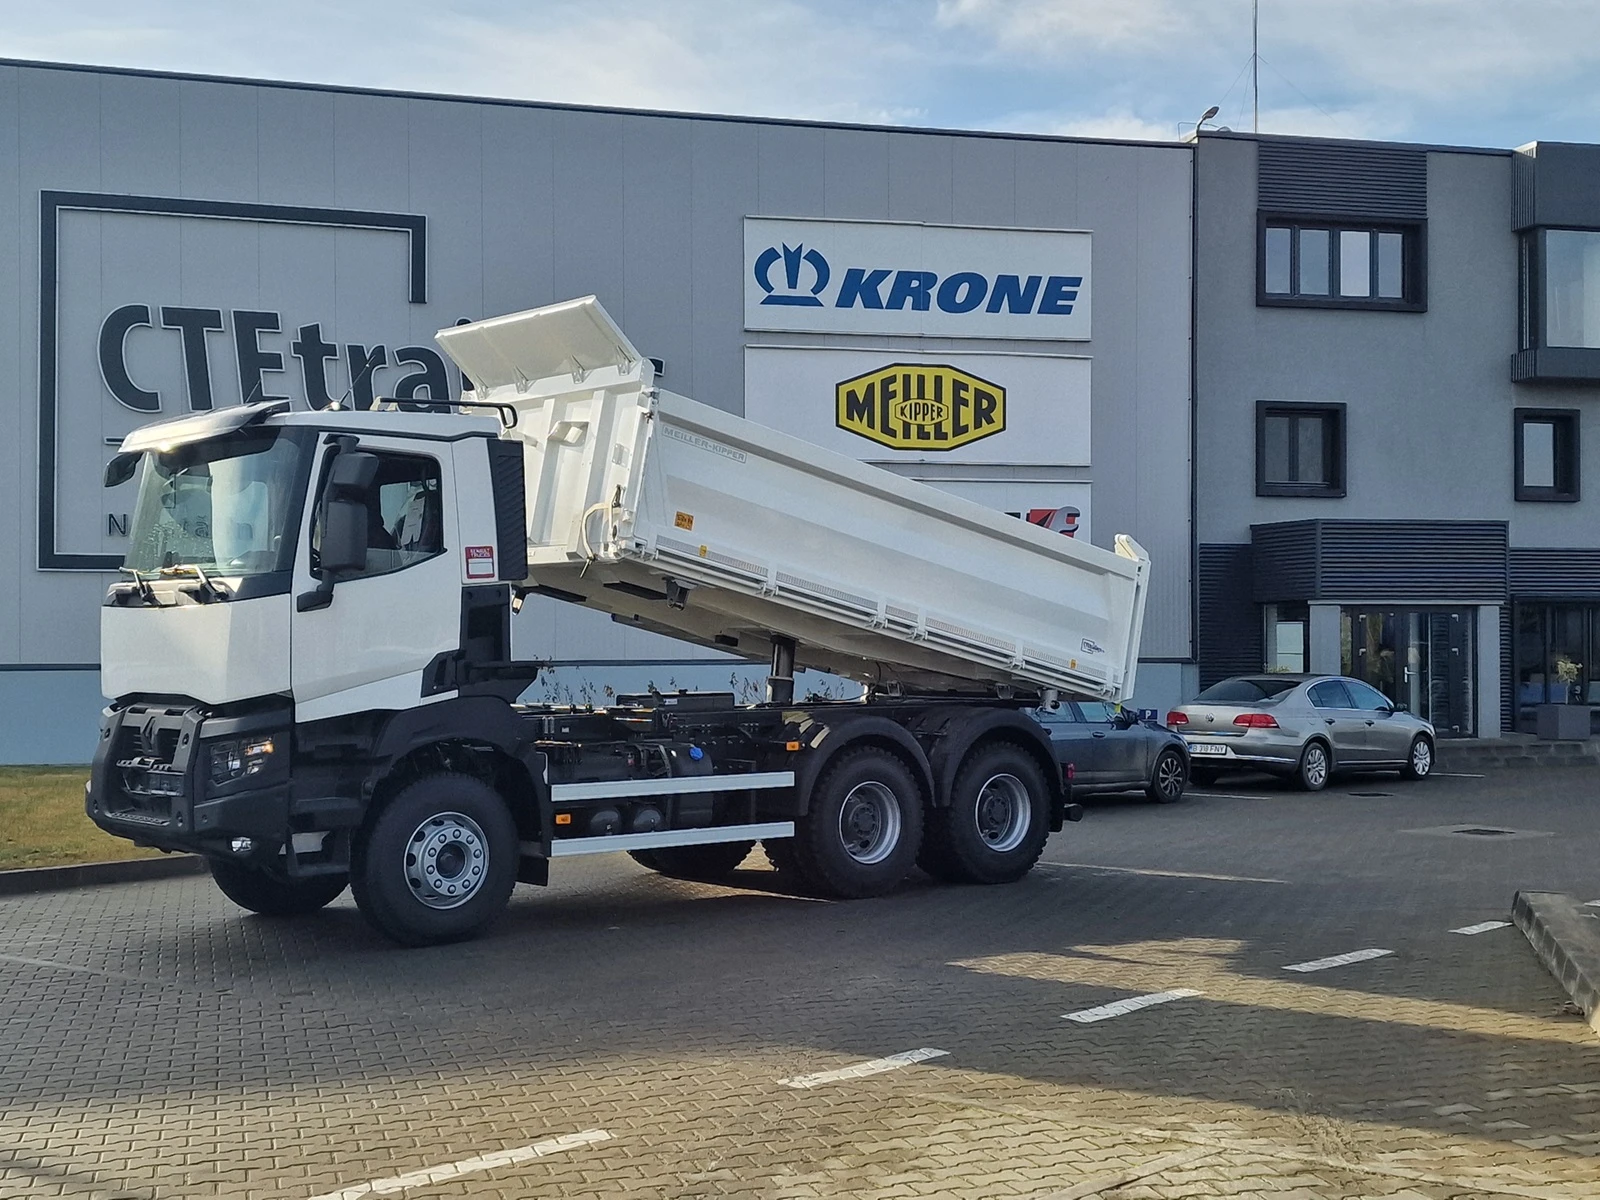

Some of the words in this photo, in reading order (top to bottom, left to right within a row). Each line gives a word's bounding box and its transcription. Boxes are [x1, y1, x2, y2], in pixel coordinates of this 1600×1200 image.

[835, 268, 1083, 315] KRONE
[97, 303, 475, 413] CTEtra
[846, 374, 997, 441] MEILLER
[900, 402, 944, 422] KIPPER
[663, 426, 745, 461] MEILLER-KIPPER
[1145, 710, 1151, 719] P
